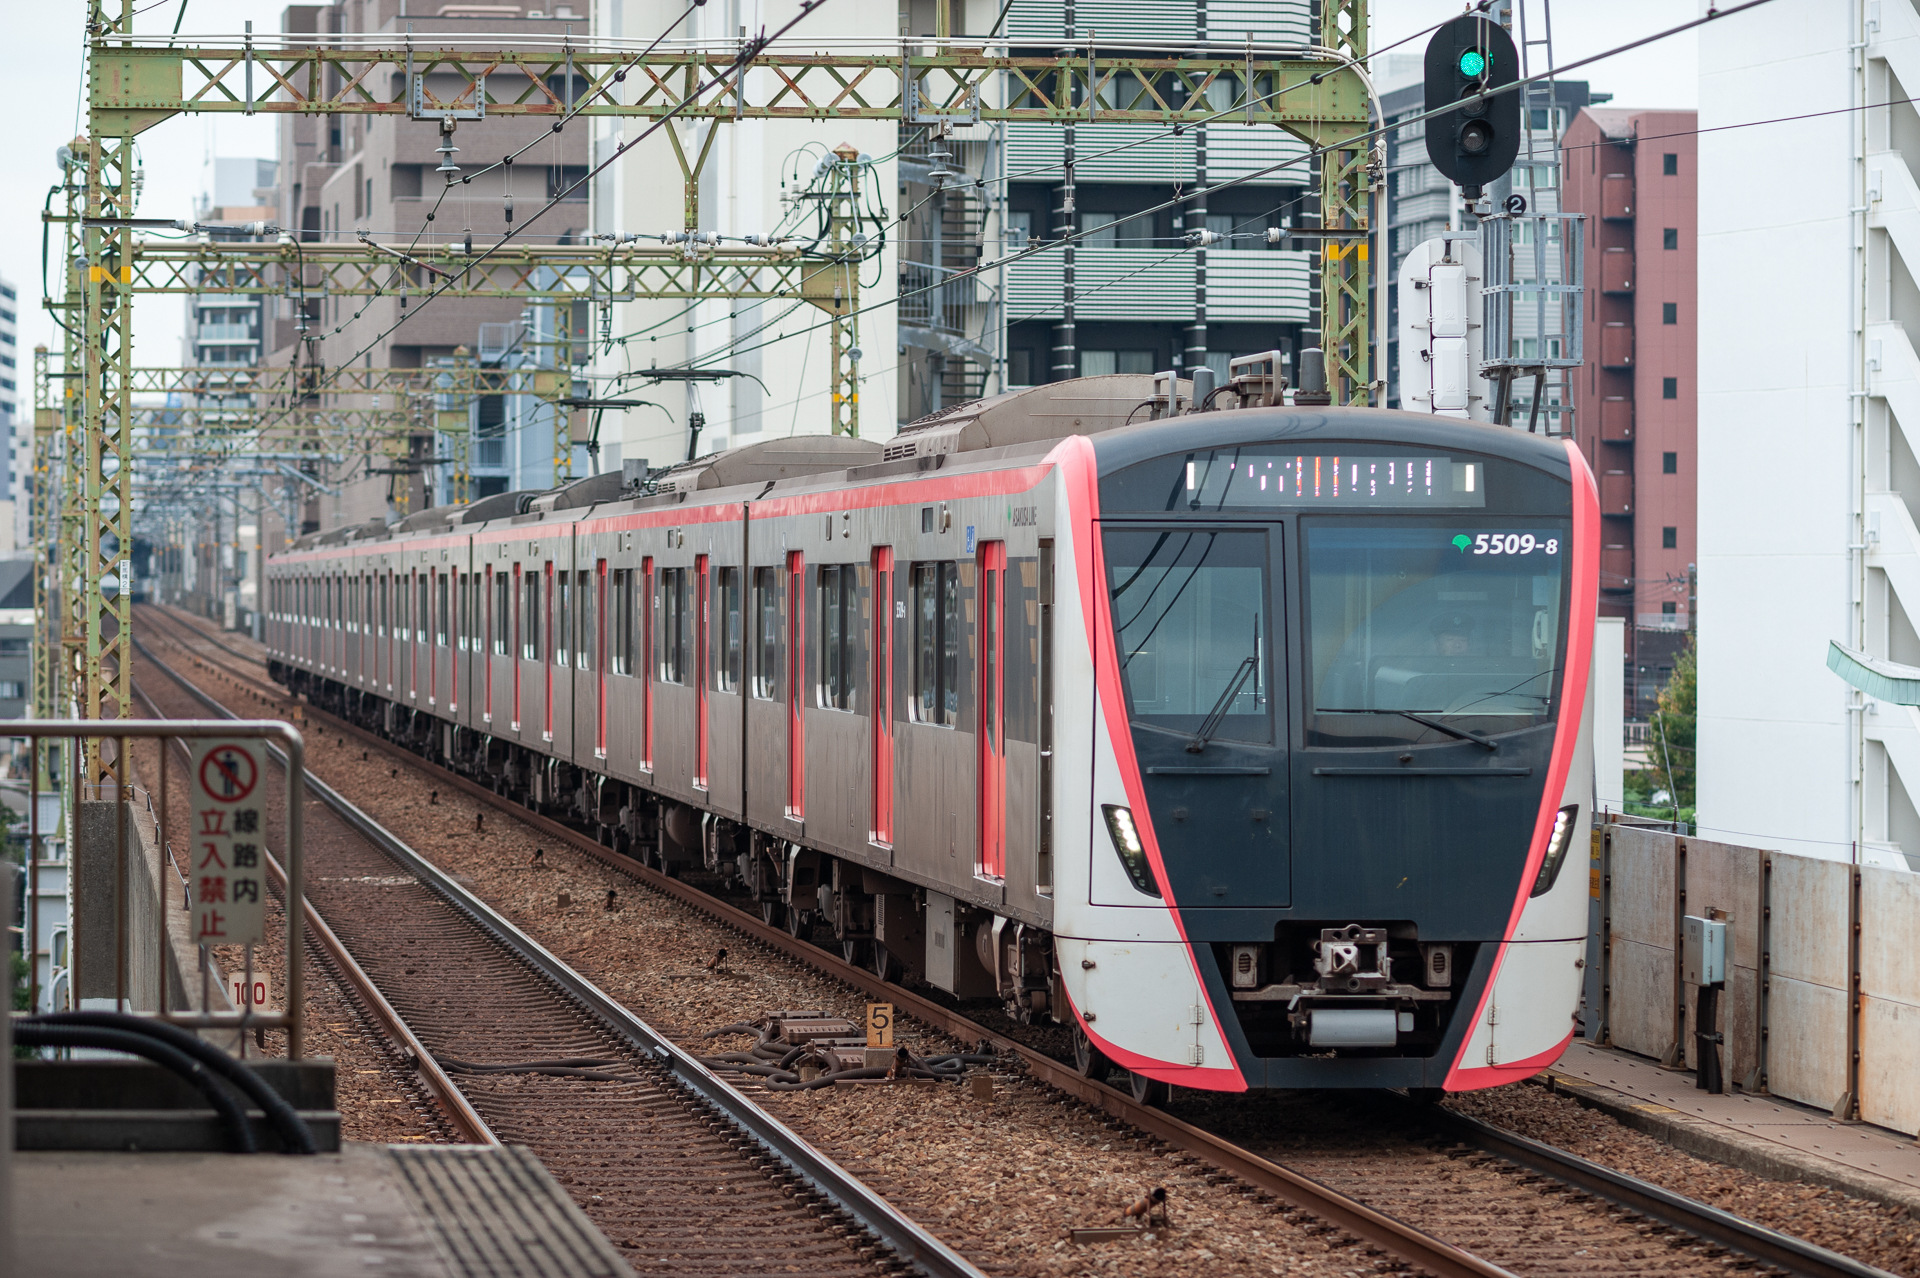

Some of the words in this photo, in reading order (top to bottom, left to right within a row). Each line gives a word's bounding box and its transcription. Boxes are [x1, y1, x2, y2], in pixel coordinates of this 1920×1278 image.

[1510, 197, 1522, 213] 2
[1473, 534, 1558, 554] 5509-8
[233, 808, 258, 904] 線路内
[199, 808, 227, 937] 立入禁止
[234, 982, 265, 1005] 100
[872, 1007, 889, 1029] 5
[876, 1031, 882, 1044] 1
